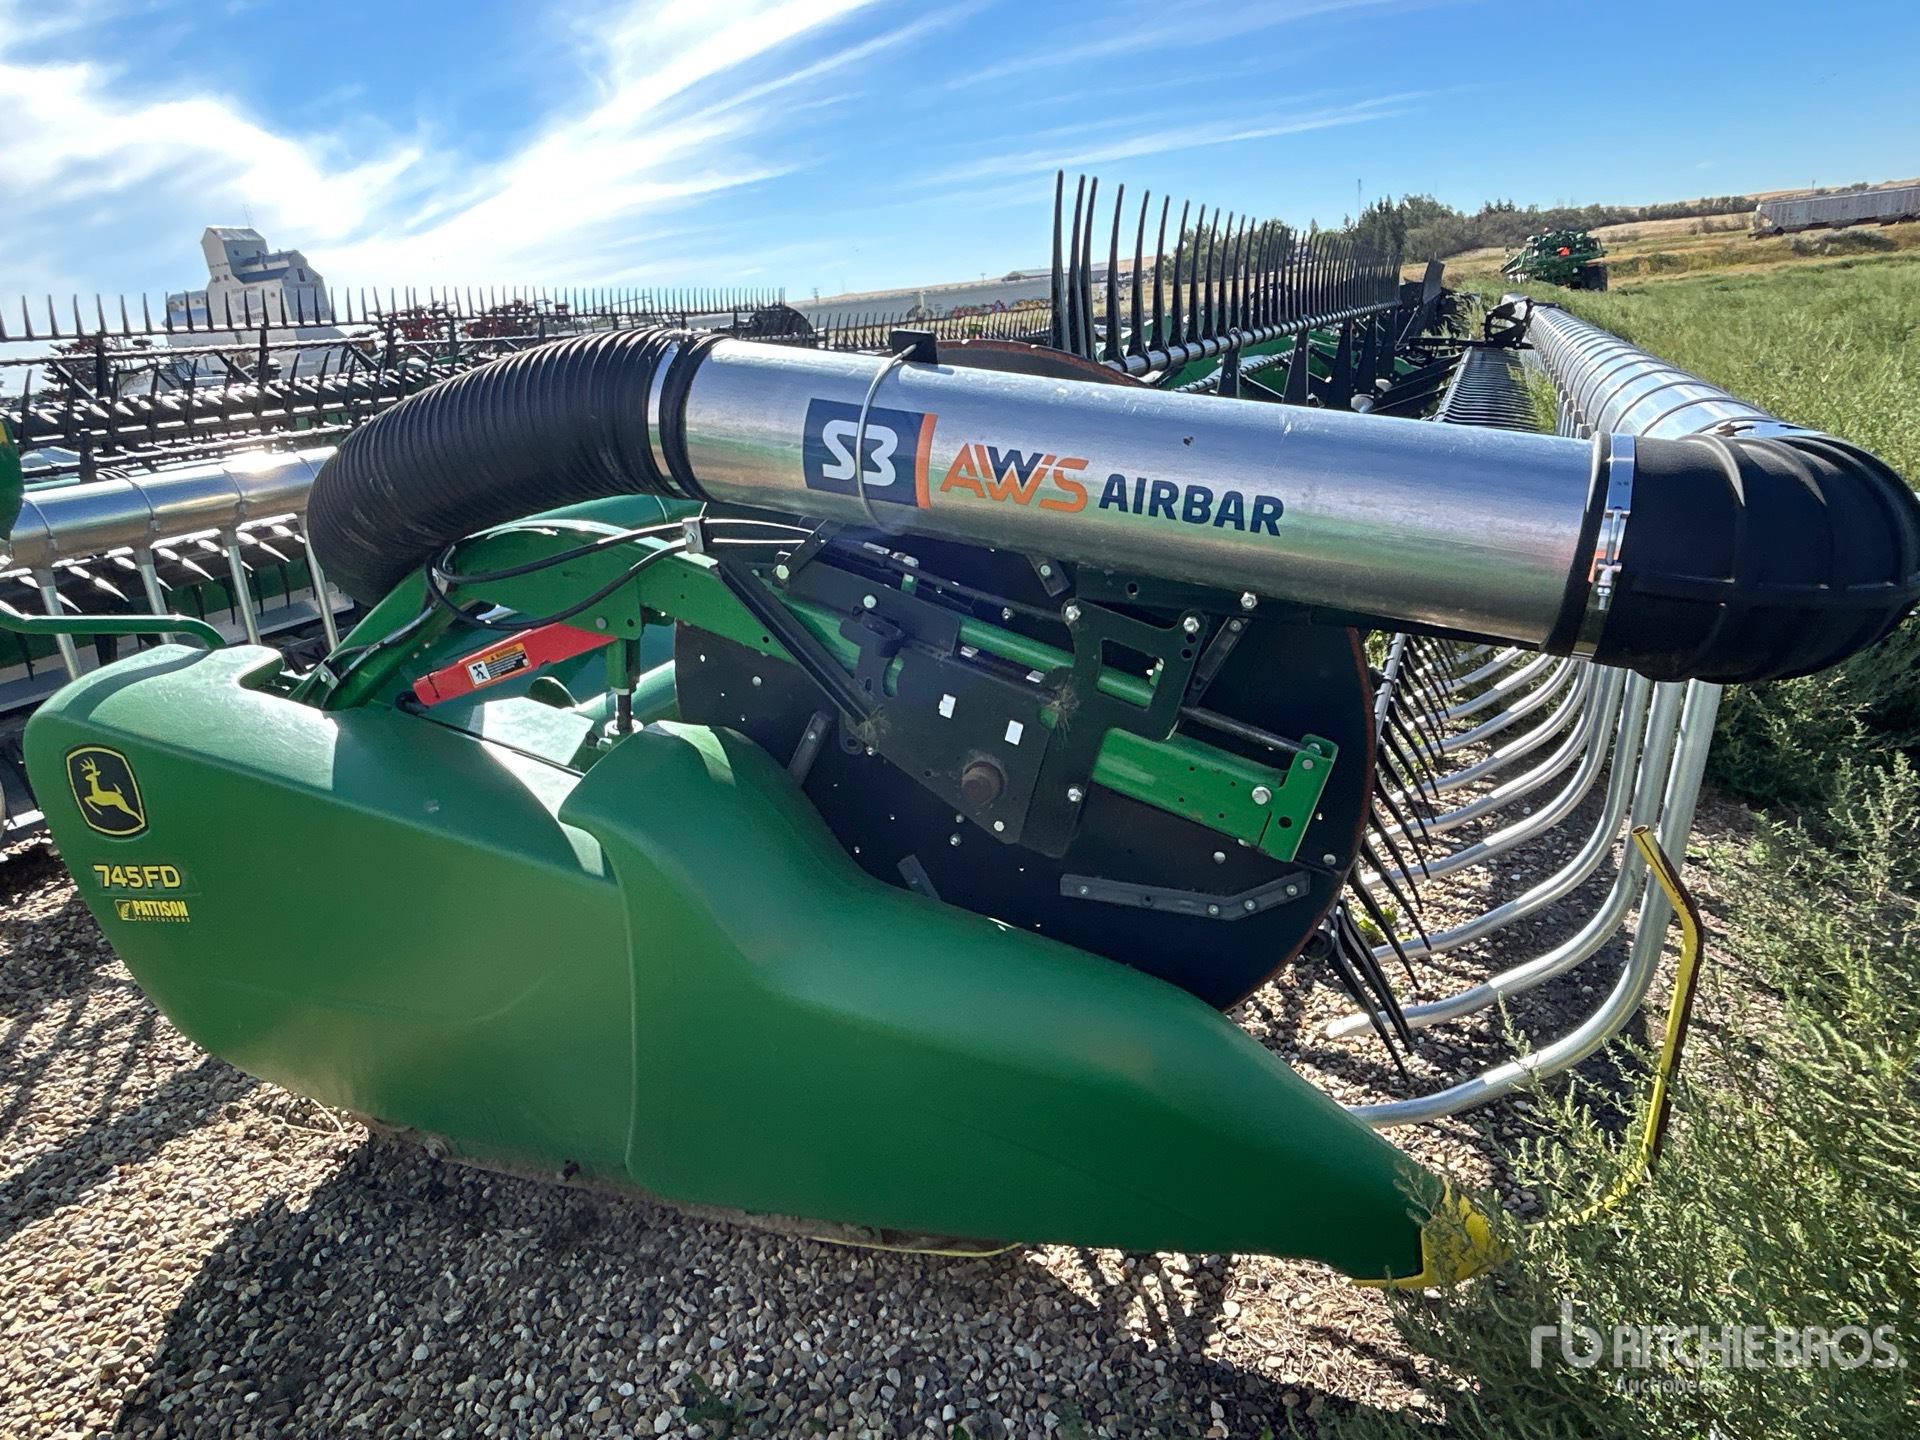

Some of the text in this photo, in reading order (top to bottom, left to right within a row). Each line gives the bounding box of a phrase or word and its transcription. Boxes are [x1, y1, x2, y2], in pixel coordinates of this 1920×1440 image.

[939, 443, 1284, 537] AWS AIRBAR
[93, 864, 181, 888] 745FD
[132, 900, 189, 916] PATTISON
